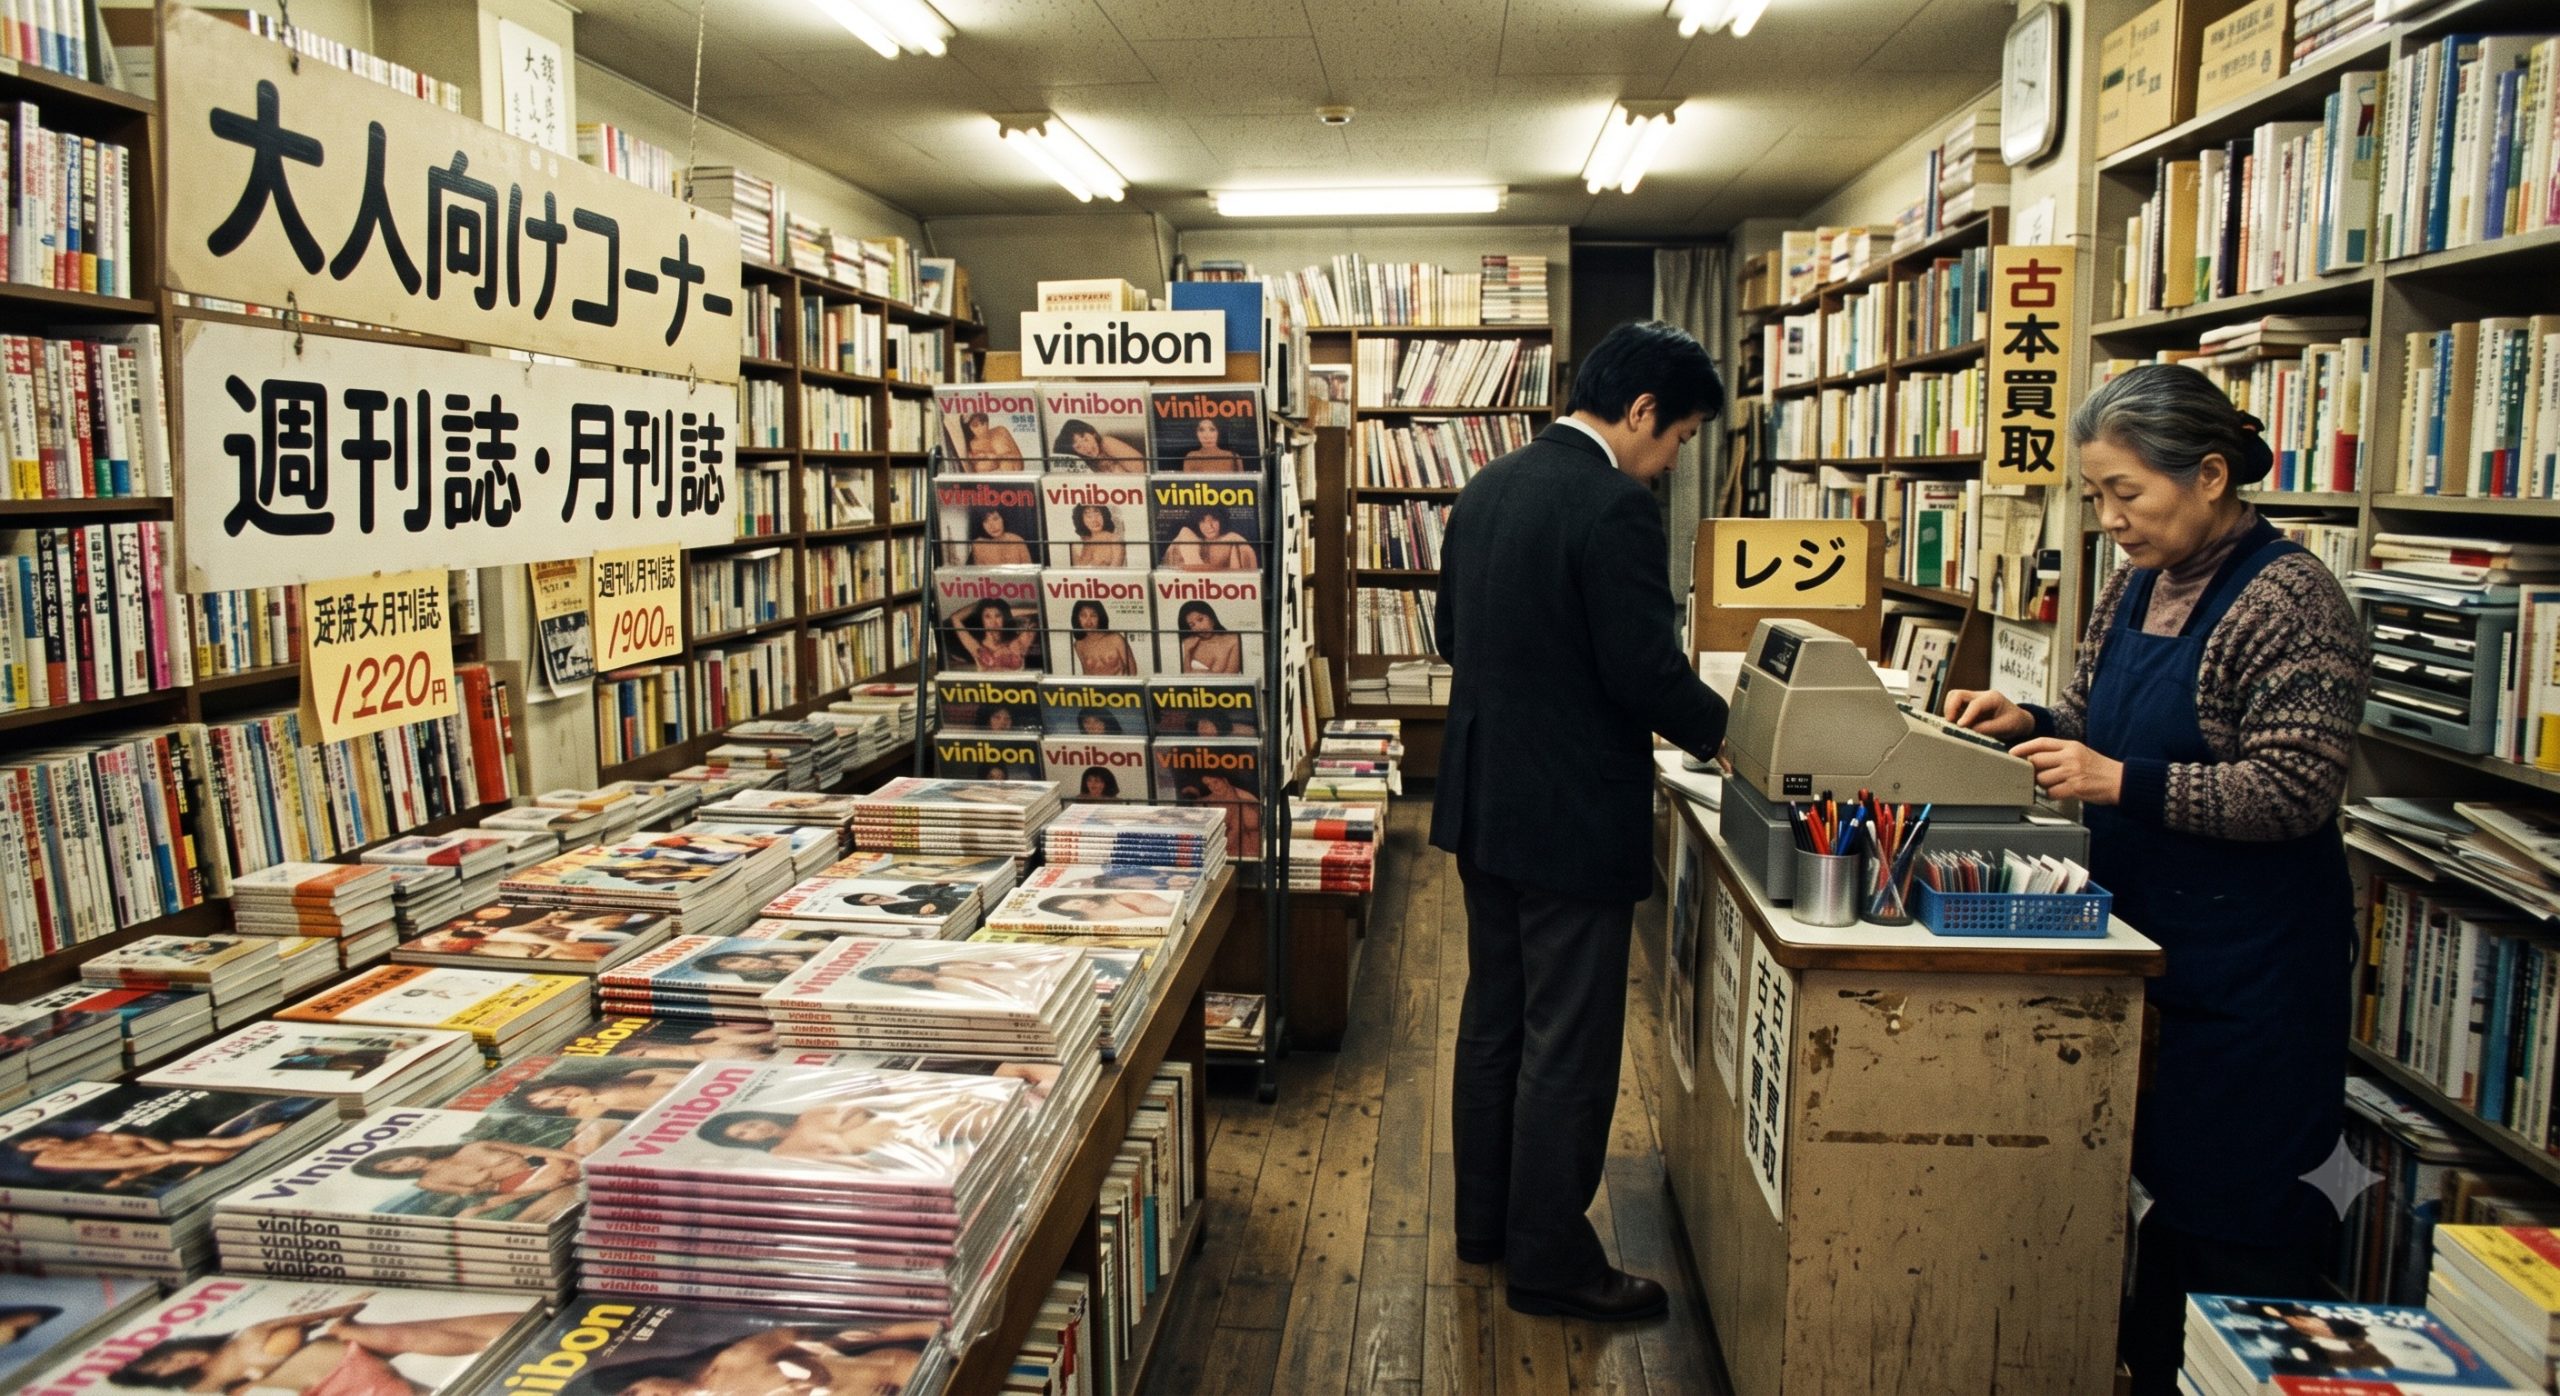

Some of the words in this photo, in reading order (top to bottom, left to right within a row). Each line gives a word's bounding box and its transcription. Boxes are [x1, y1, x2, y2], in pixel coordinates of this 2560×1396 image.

[206, 79, 734, 348] 大人向けコーナー
[1032, 321, 1212, 366] vinibon
[1998, 257, 2063, 474] 古本買取
[938, 392, 1035, 414] vinibon
[1047, 392, 1144, 414] vinibon
[1154, 395, 1254, 419] vinibon
[222, 374, 727, 538] 週刊誌・月刊誌
[938, 484, 1035, 508] vinibon
[1046, 484, 1144, 506] vinibon
[1155, 482, 1254, 506] vinibon
[1735, 535, 1847, 593] レジ
[939, 577, 1036, 600] vinibon
[1046, 577, 1144, 600] vinibon
[1158, 578, 1257, 600] vinibon
[608, 605, 675, 659] 1900円
[940, 682, 1037, 704] vinibon
[1043, 686, 1141, 709] vinibon
[1152, 686, 1253, 709] vinibon
[938, 742, 1036, 765] vinibon
[1046, 745, 1143, 767] vinibon
[1156, 748, 1255, 770] vinibon
[619, 1067, 757, 1160] vinibon
[250, 1110, 424, 1202] vinibon
[257, 1215, 340, 1236] vinibon
[259, 1234, 342, 1251] vinibon
[261, 1248, 344, 1264] vinibon
[263, 1261, 347, 1278] vinibon
[504, 1304, 637, 1396] ibon
